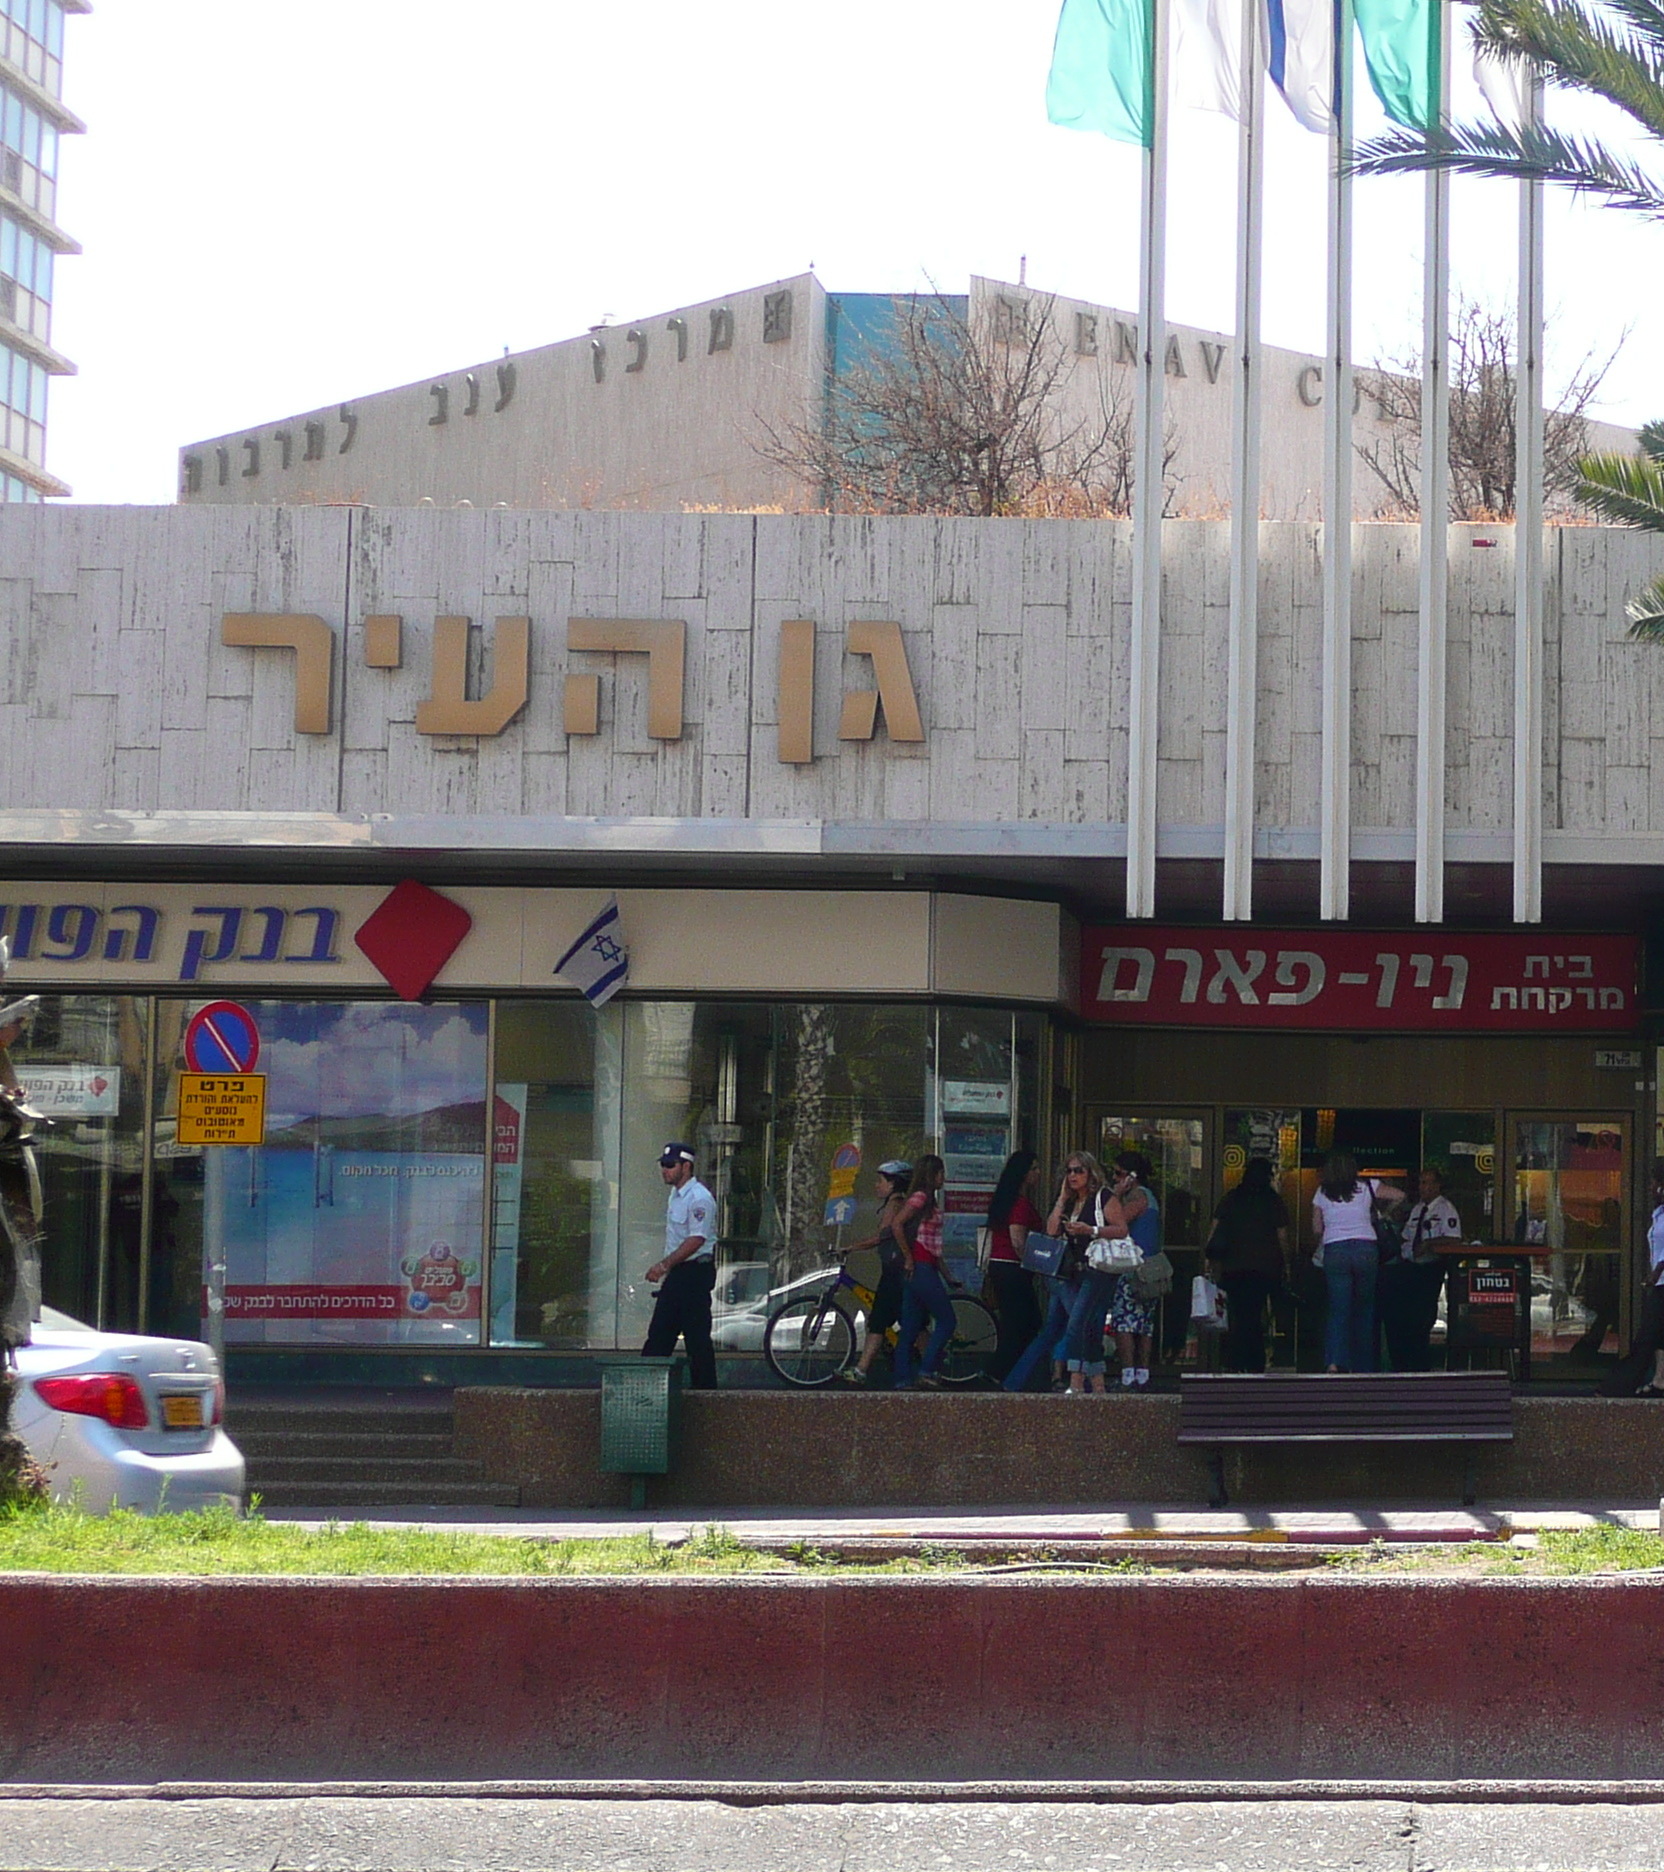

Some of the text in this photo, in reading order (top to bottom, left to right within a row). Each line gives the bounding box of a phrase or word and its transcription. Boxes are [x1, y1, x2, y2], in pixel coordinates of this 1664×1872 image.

[1075, 312, 1227, 384] ENAV
[183, 305, 735, 494] מרכז ענב לתרבות
[222, 612, 926, 763] גן העיר
[0, 904, 338, 980] בנק הפו
[1523, 954, 1593, 979] בית
[1096, 945, 1470, 1009] ניו-פארם
[1490, 986, 1625, 1014] מרקחת
[199, 1081, 244, 1092] פרט
[204, 1106, 237, 1115] נוסעים
[196, 1118, 245, 1127] מאוטובוס
[420, 1274, 456, 1289] סביבך
[1476, 1277, 1510, 1291] בטחון
[244, 1294, 275, 1311] לבנק
[277, 1293, 329, 1308] להתחבר
[331, 1295, 376, 1308] הדרכים
[379, 1294, 395, 1308] כל
